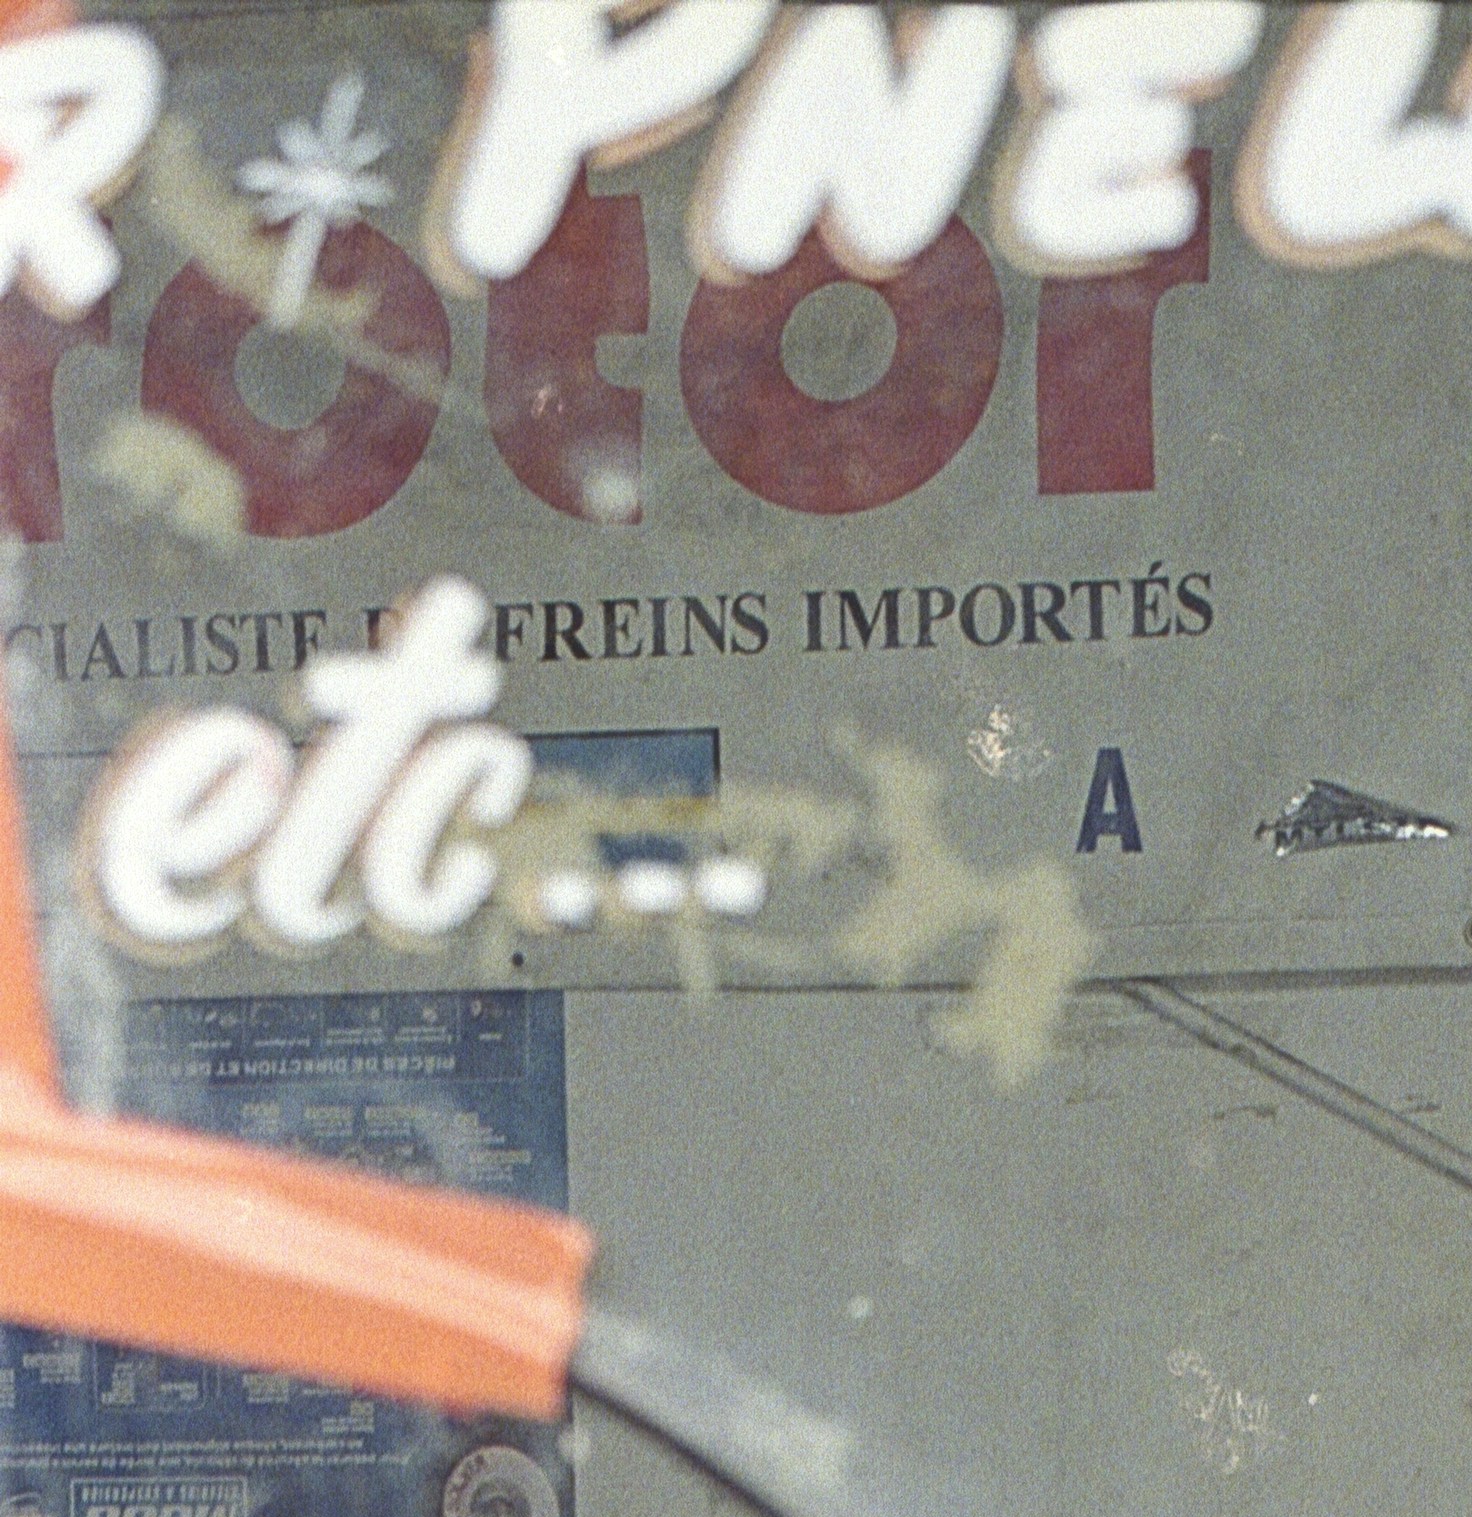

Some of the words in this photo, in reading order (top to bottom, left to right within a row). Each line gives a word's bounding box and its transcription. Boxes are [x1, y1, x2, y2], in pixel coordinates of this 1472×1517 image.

[495, 593, 770, 664] FREINS
[804, 563, 1214, 654] IMPORTÉS
[1075, 747, 1144, 853] A
